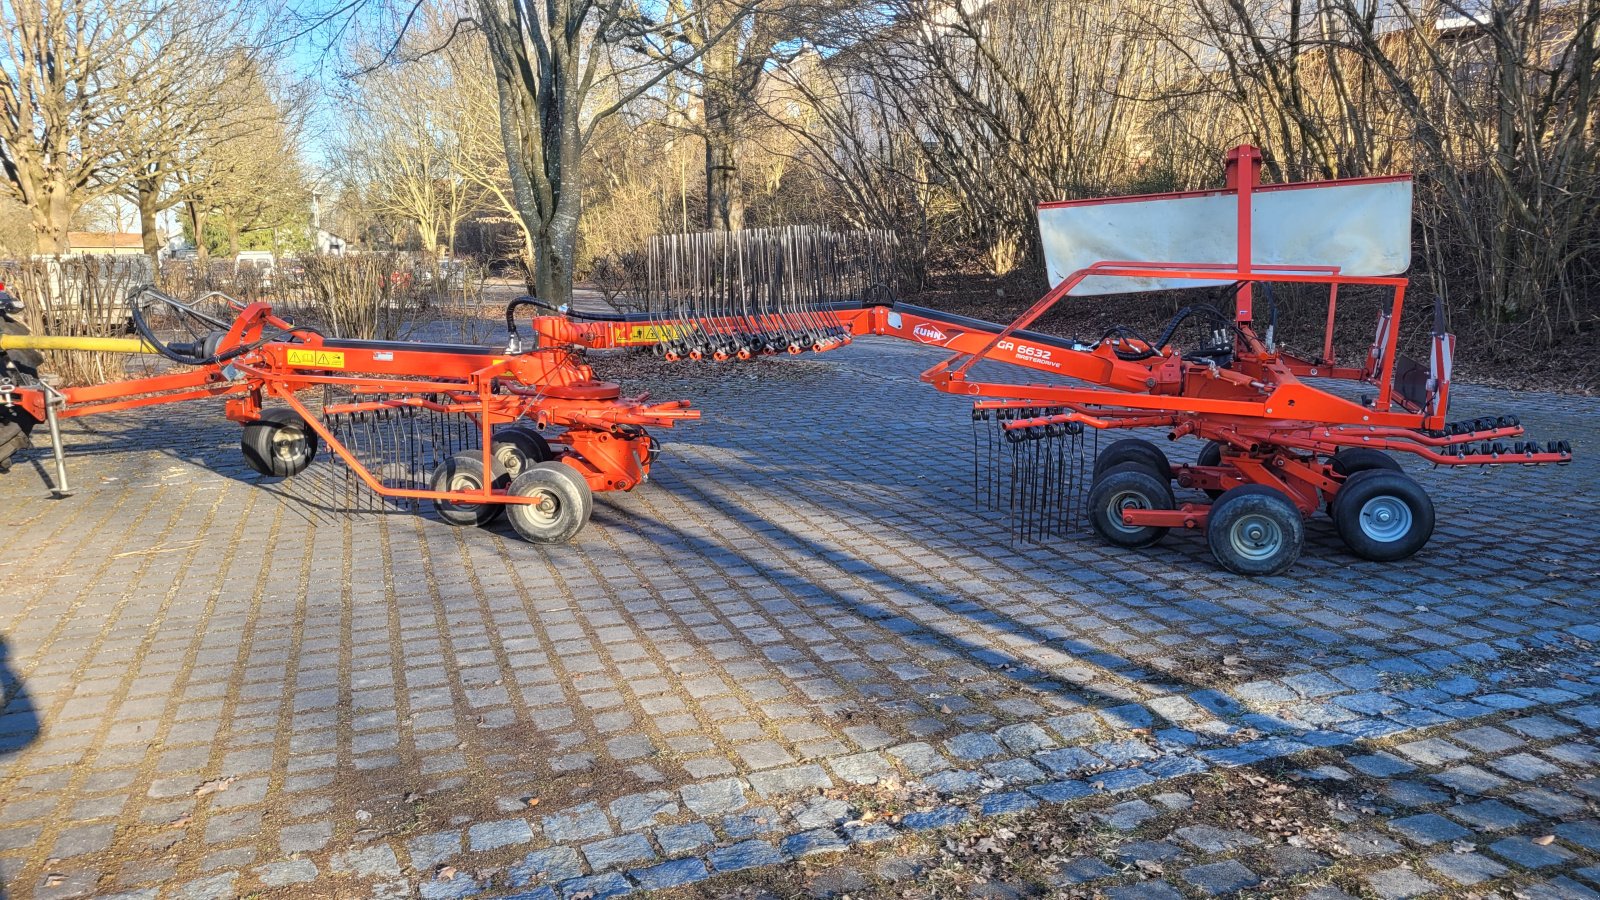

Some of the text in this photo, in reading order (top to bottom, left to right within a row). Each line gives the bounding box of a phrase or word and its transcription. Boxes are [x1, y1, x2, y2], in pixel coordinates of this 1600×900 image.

[914, 326, 942, 340] KUHN
[997, 340, 1052, 359] GA 6632
[1015, 353, 1061, 368] MASTERDRIVE
